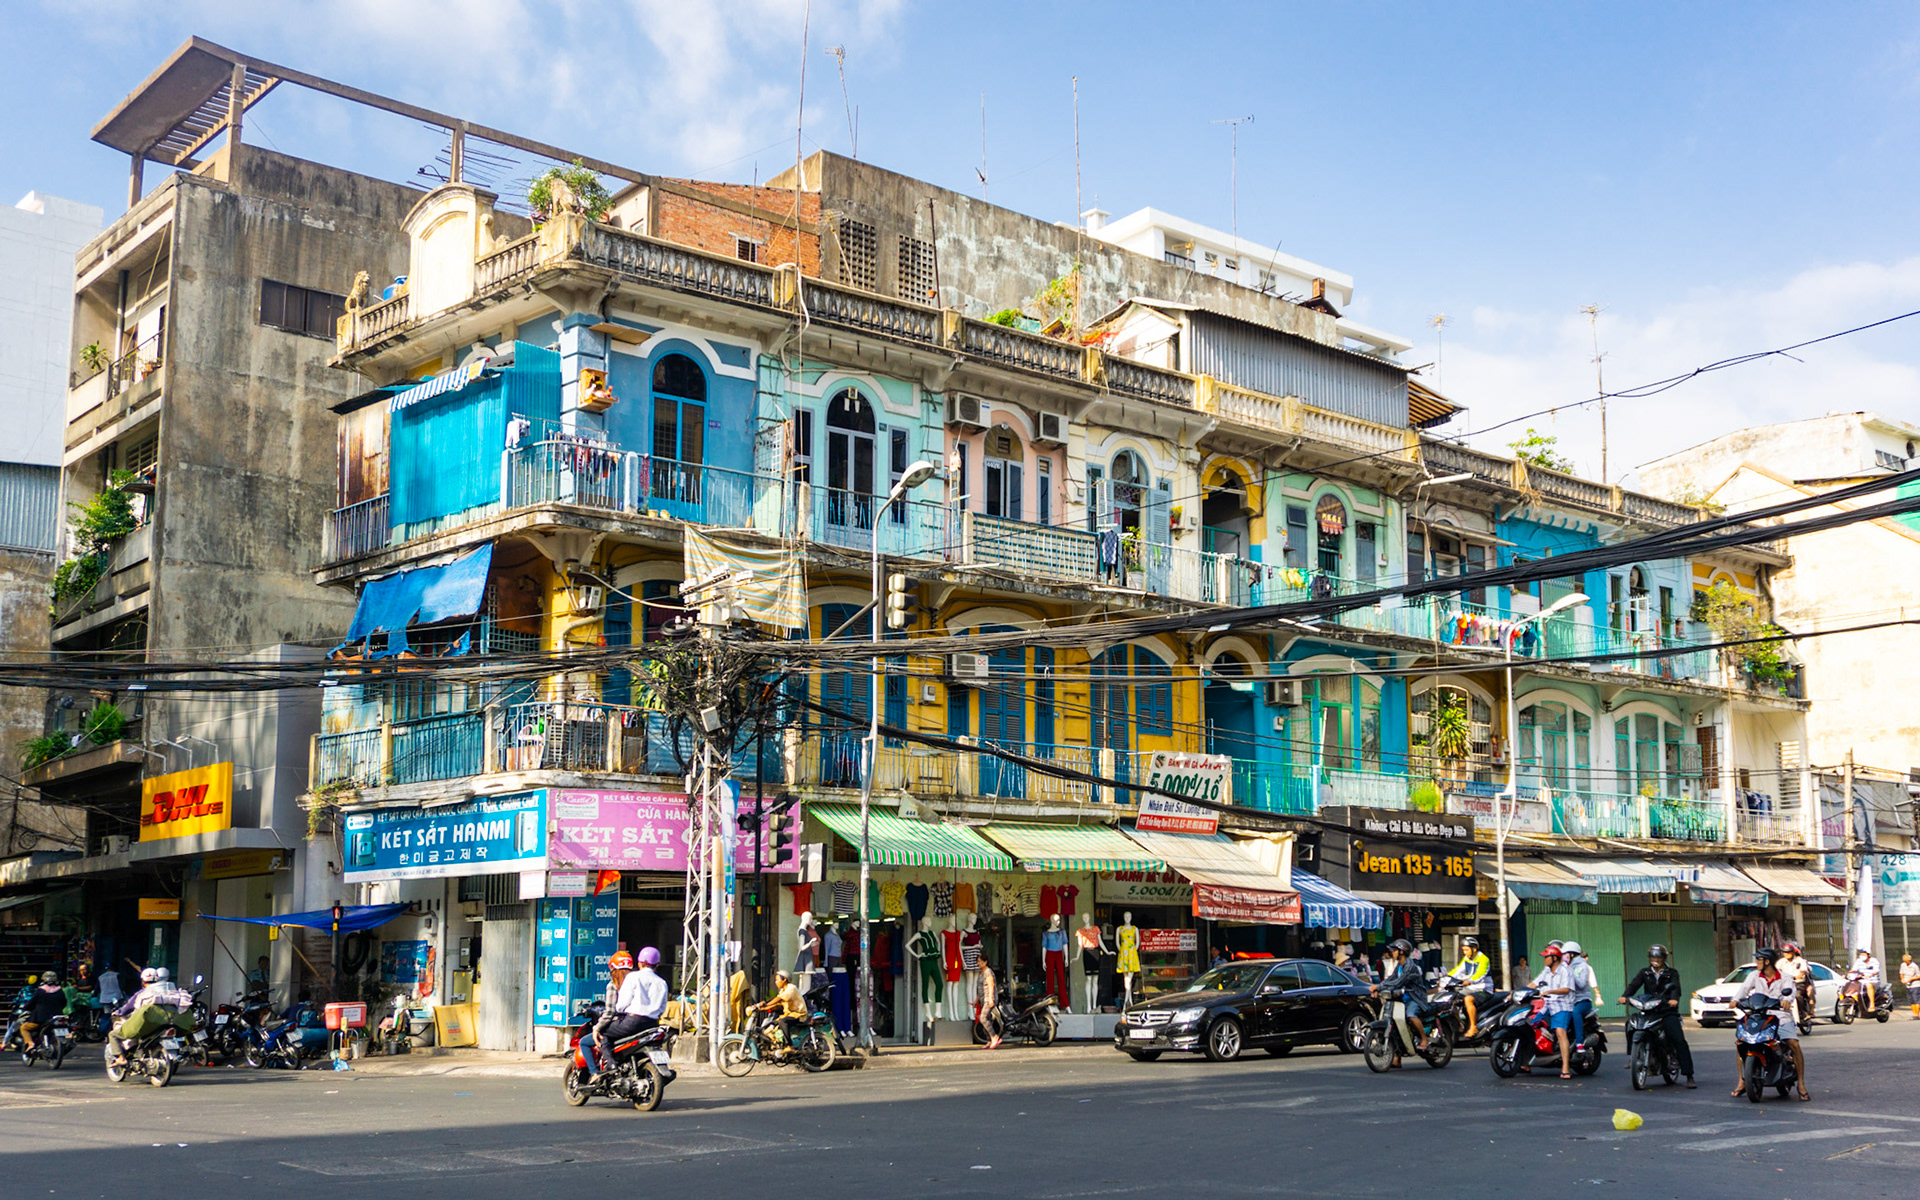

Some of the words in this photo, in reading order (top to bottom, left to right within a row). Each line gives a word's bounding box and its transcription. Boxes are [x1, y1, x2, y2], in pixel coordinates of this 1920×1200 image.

[1149, 773, 1223, 800] 5000đ/1ổ
[142, 784, 223, 826] DHL
[637, 805, 661, 819] CỬA
[665, 808, 690, 820] HÀN
[381, 827, 412, 850] KÉT
[416, 820, 448, 847] SẮT
[452, 819, 511, 844] HANMI
[561, 822, 615, 843] KÉT
[622, 821, 674, 844] SẮT
[1364, 819, 1388, 833] Không
[1389, 819, 1401, 833] Chỉ
[1412, 822, 1424, 834] Mà
[1425, 822, 1438, 836] Còn
[1359, 851, 1401, 872] Jean
[1404, 854, 1432, 875] 135
[1445, 856, 1473, 877] 165
[1881, 853, 1907, 866] 428
[594, 905, 617, 918] CHỐNG
[597, 925, 614, 937] CHÁY
[593, 951, 612, 965] CHỐN
